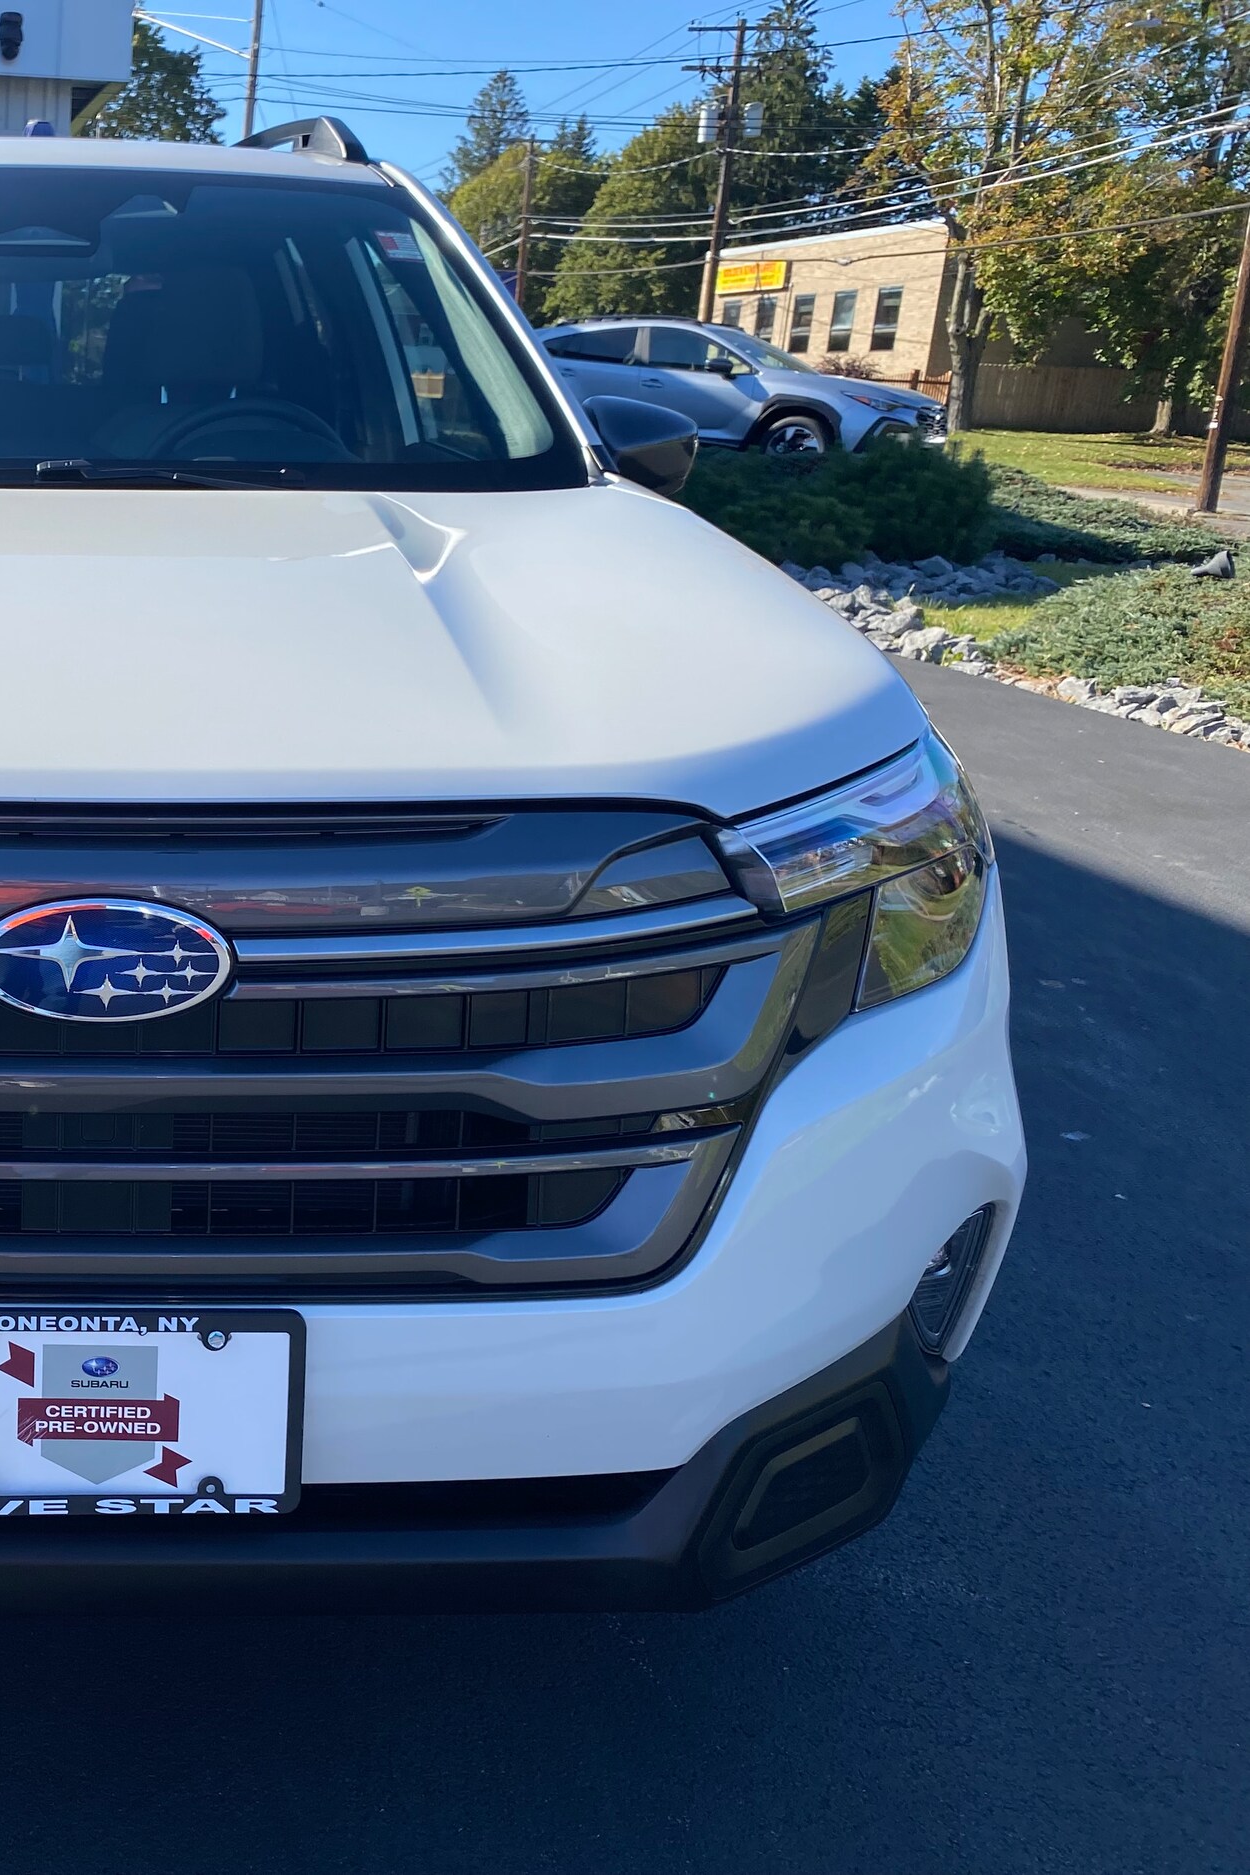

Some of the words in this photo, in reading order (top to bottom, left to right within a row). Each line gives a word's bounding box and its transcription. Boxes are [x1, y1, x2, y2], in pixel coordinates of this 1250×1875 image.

[157, 1316, 200, 1332] NY
[70, 1379, 129, 1389] SUBARU
[45, 1404, 151, 1419] CERTIFIED
[34, 1420, 161, 1436] PRE-OWNED
[94, 1498, 280, 1515] STAR
